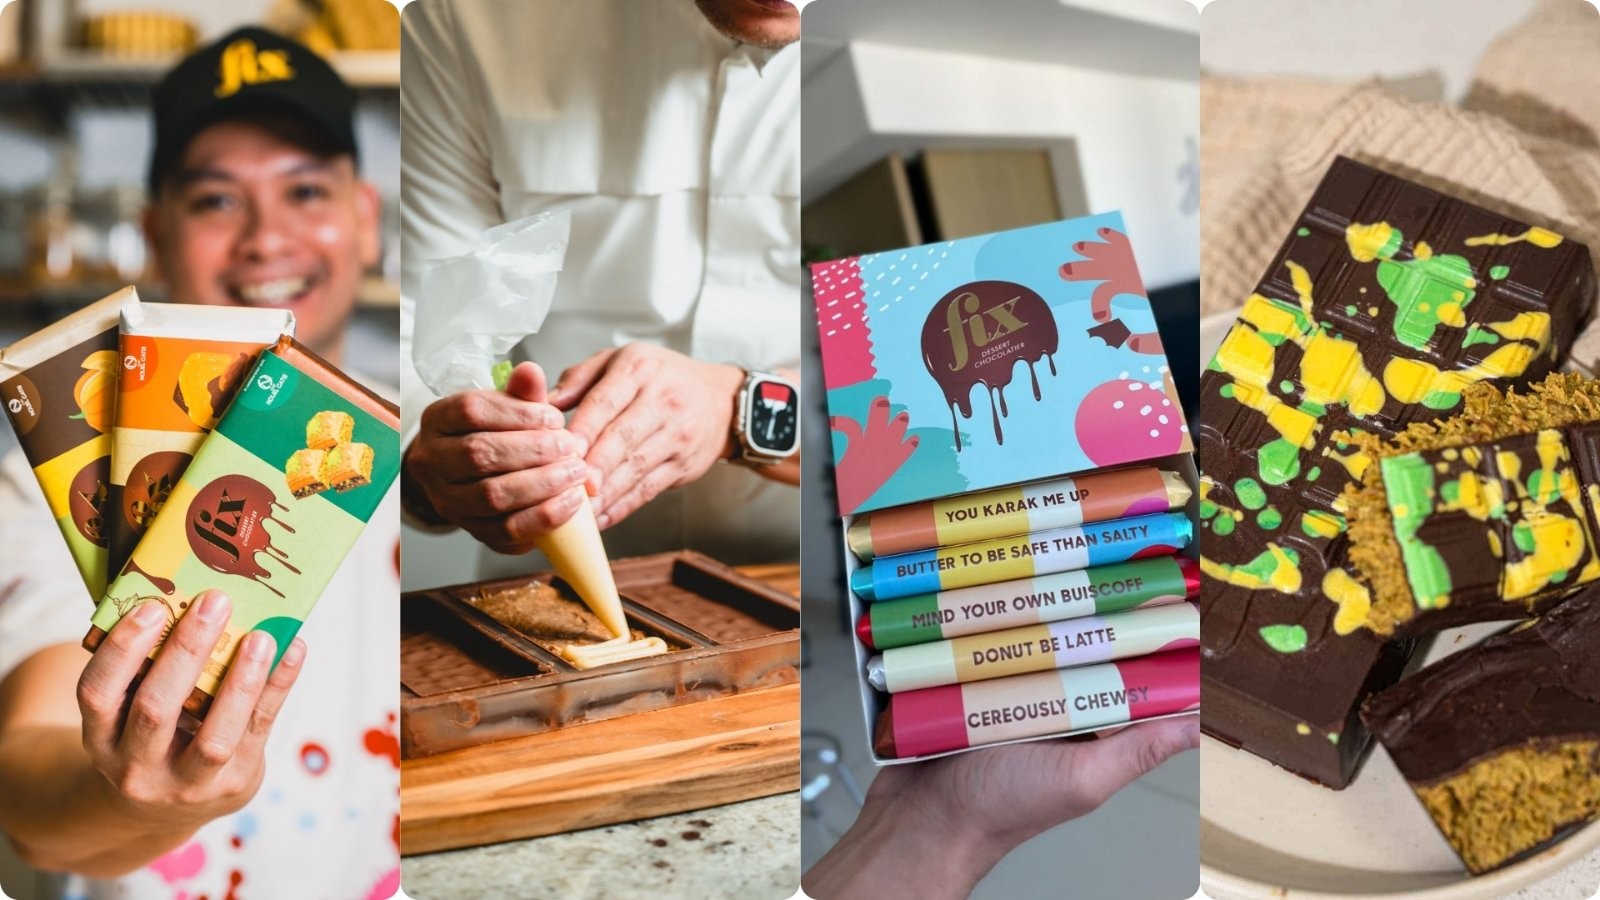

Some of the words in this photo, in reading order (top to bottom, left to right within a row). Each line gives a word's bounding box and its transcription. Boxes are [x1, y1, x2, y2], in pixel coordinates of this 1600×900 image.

[214, 39, 296, 98] fix
[943, 292, 1029, 371] fix
[981, 340, 1010, 357] DESSERT
[974, 342, 1025, 368] CHOCOLATIER
[193, 487, 247, 563] fix
[946, 507, 978, 523] YOU
[983, 499, 1038, 517] KARAK
[1043, 494, 1066, 508] ME
[1071, 489, 1090, 503] UP
[240, 516, 250, 538] DESSERT
[242, 510, 258, 547] CHOCOLATIER
[896, 556, 956, 578] BUTTER
[960, 552, 983, 567] TO
[987, 548, 1007, 562] BE
[1011, 541, 1049, 559] SAFE
[1053, 534, 1098, 551] THAN
[1102, 525, 1149, 543] SALTY
[912, 609, 956, 629] MIND
[961, 602, 1007, 620] YOUR
[1012, 593, 1056, 611] OWN
[1061, 578, 1144, 601] BUISCOFF
[972, 642, 1034, 667] DONUT
[1040, 637, 1061, 652] BE
[1065, 627, 1116, 650] LATTE
[967, 699, 1068, 729] CEREOUSLY
[1074, 686, 1149, 713] CHEWSY
